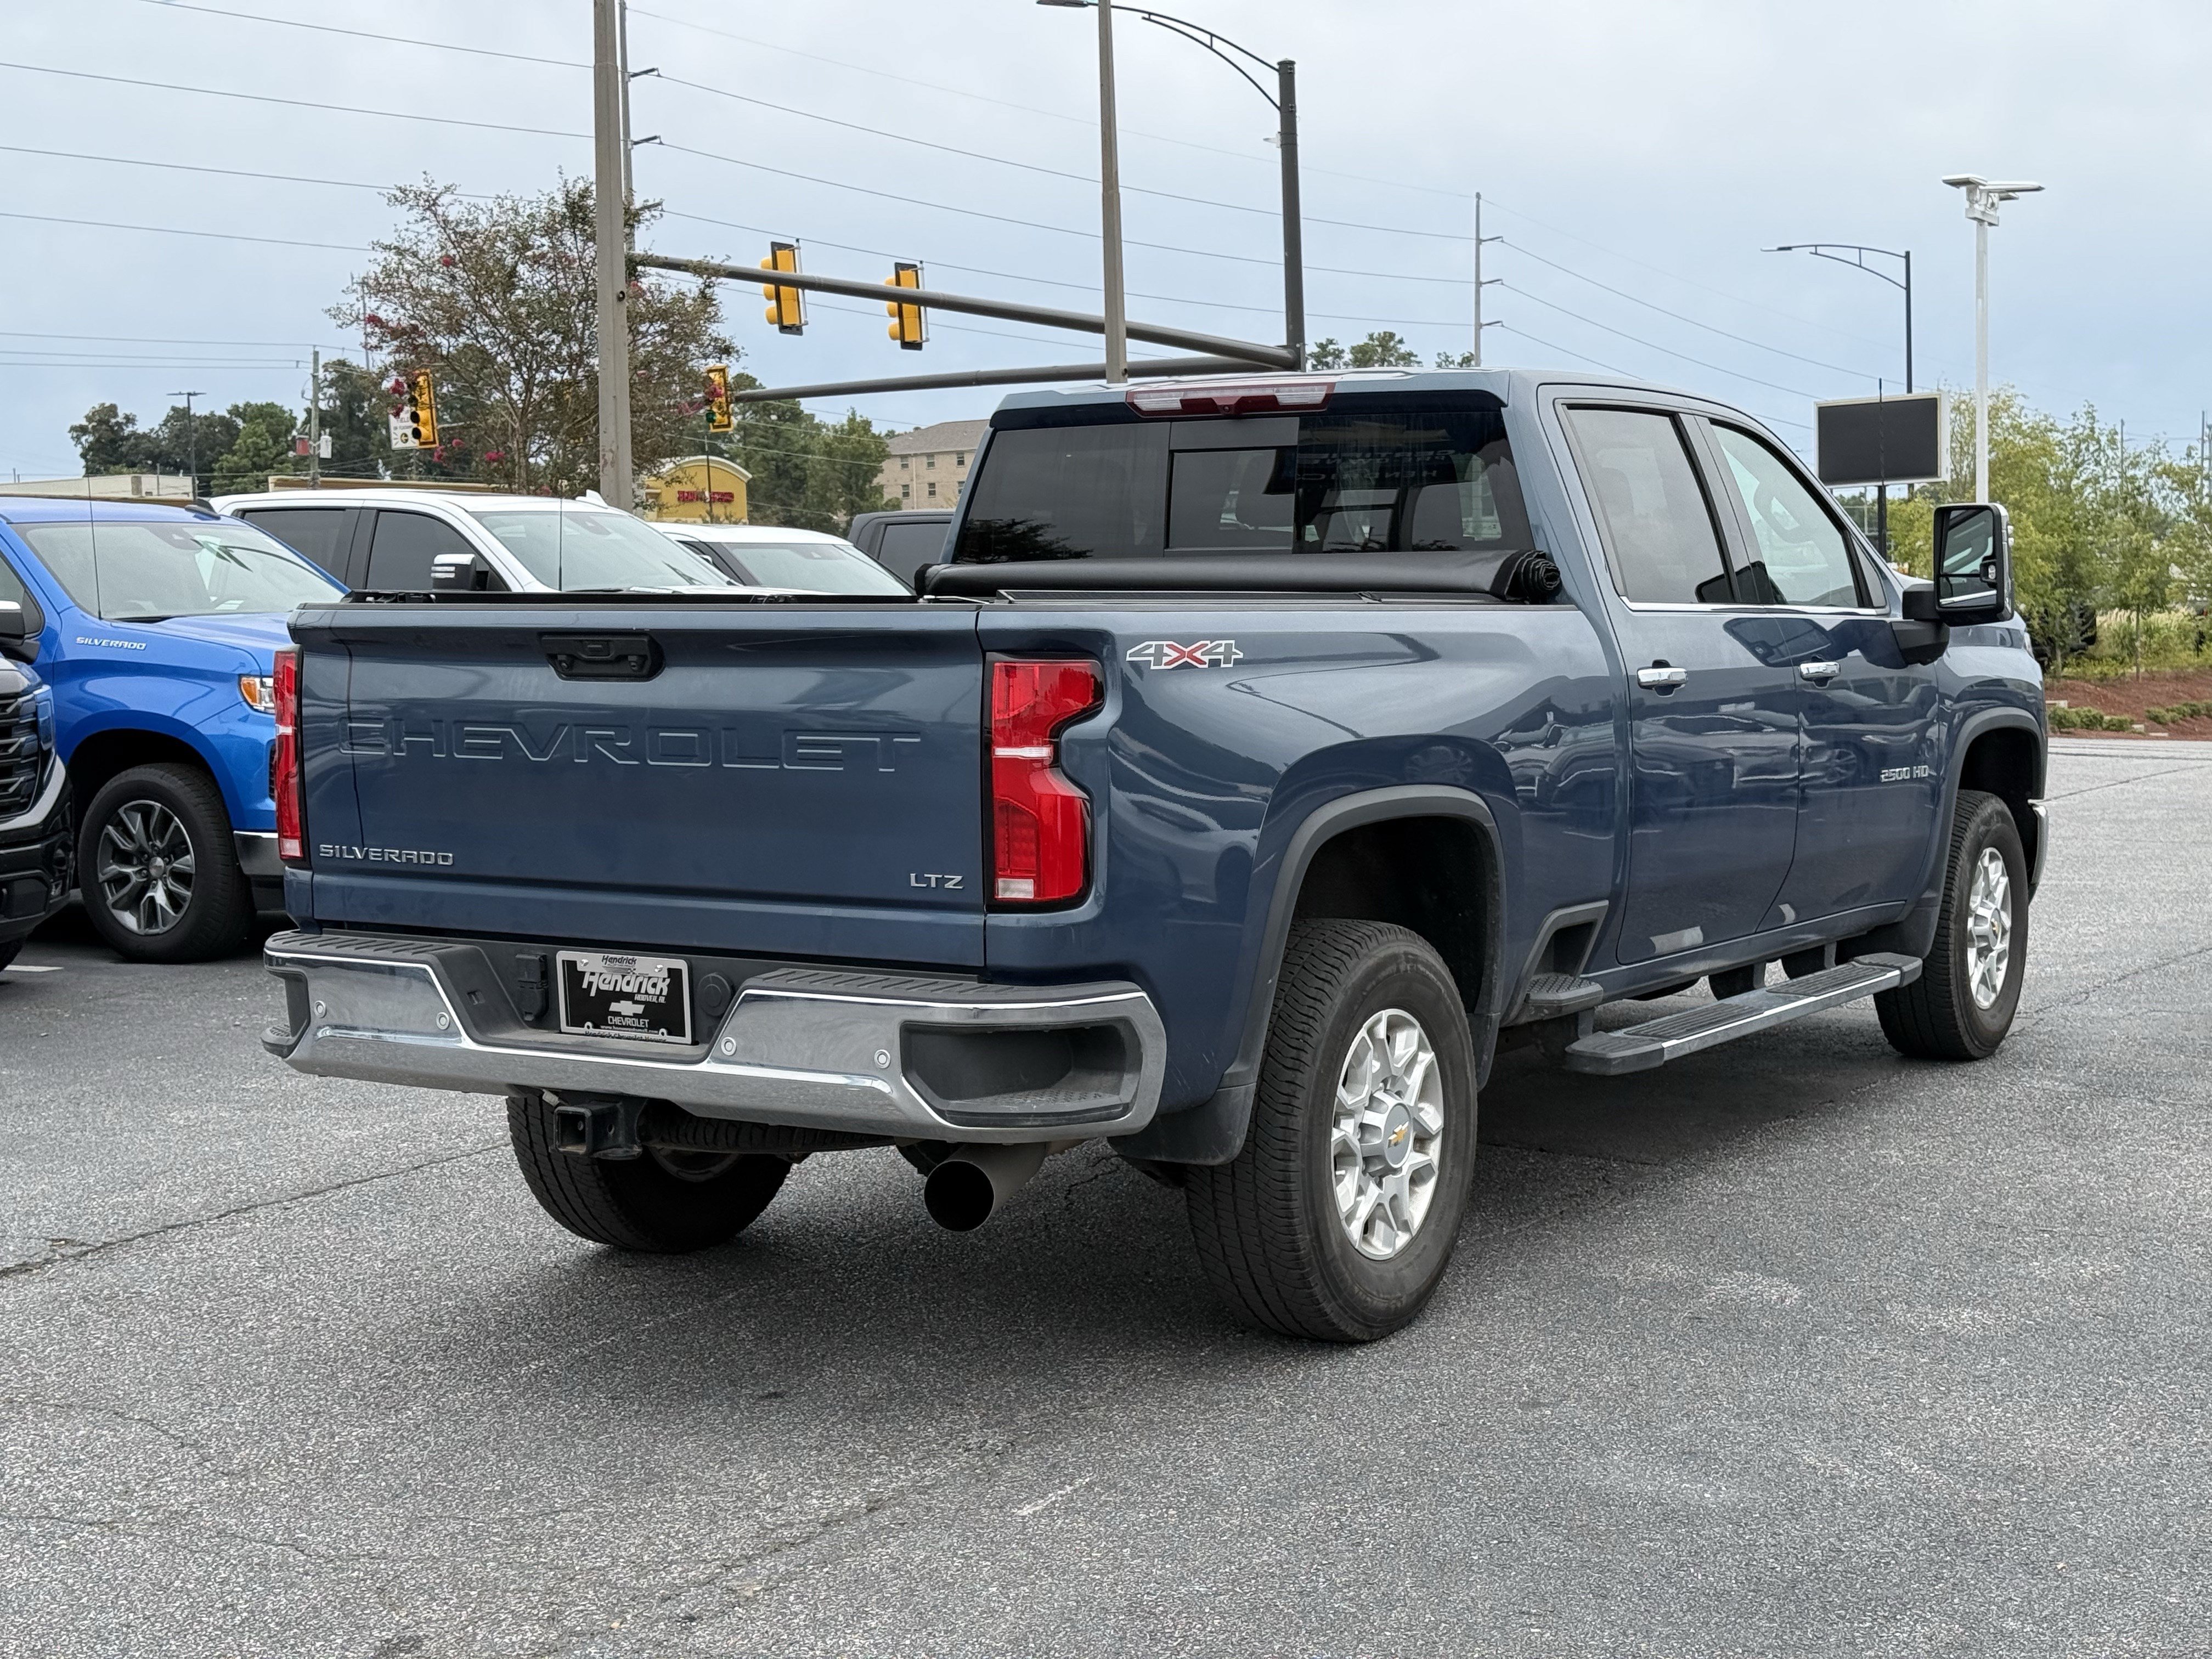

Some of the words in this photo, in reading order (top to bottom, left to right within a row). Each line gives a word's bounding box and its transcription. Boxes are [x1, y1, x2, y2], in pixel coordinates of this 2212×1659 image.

[76, 636, 147, 650] SILVERADO
[338, 718, 921, 772] CHEVROLET
[1880, 767, 1910, 783] 2500
[1913, 765, 1929, 778] HD
[319, 844, 454, 866] SILVERADO
[910, 873, 964, 889] LTZ
[602, 955, 637, 965] Hendrick
[582, 971, 670, 997] Hendrick
[607, 1015, 649, 1028] CHEVROLET
